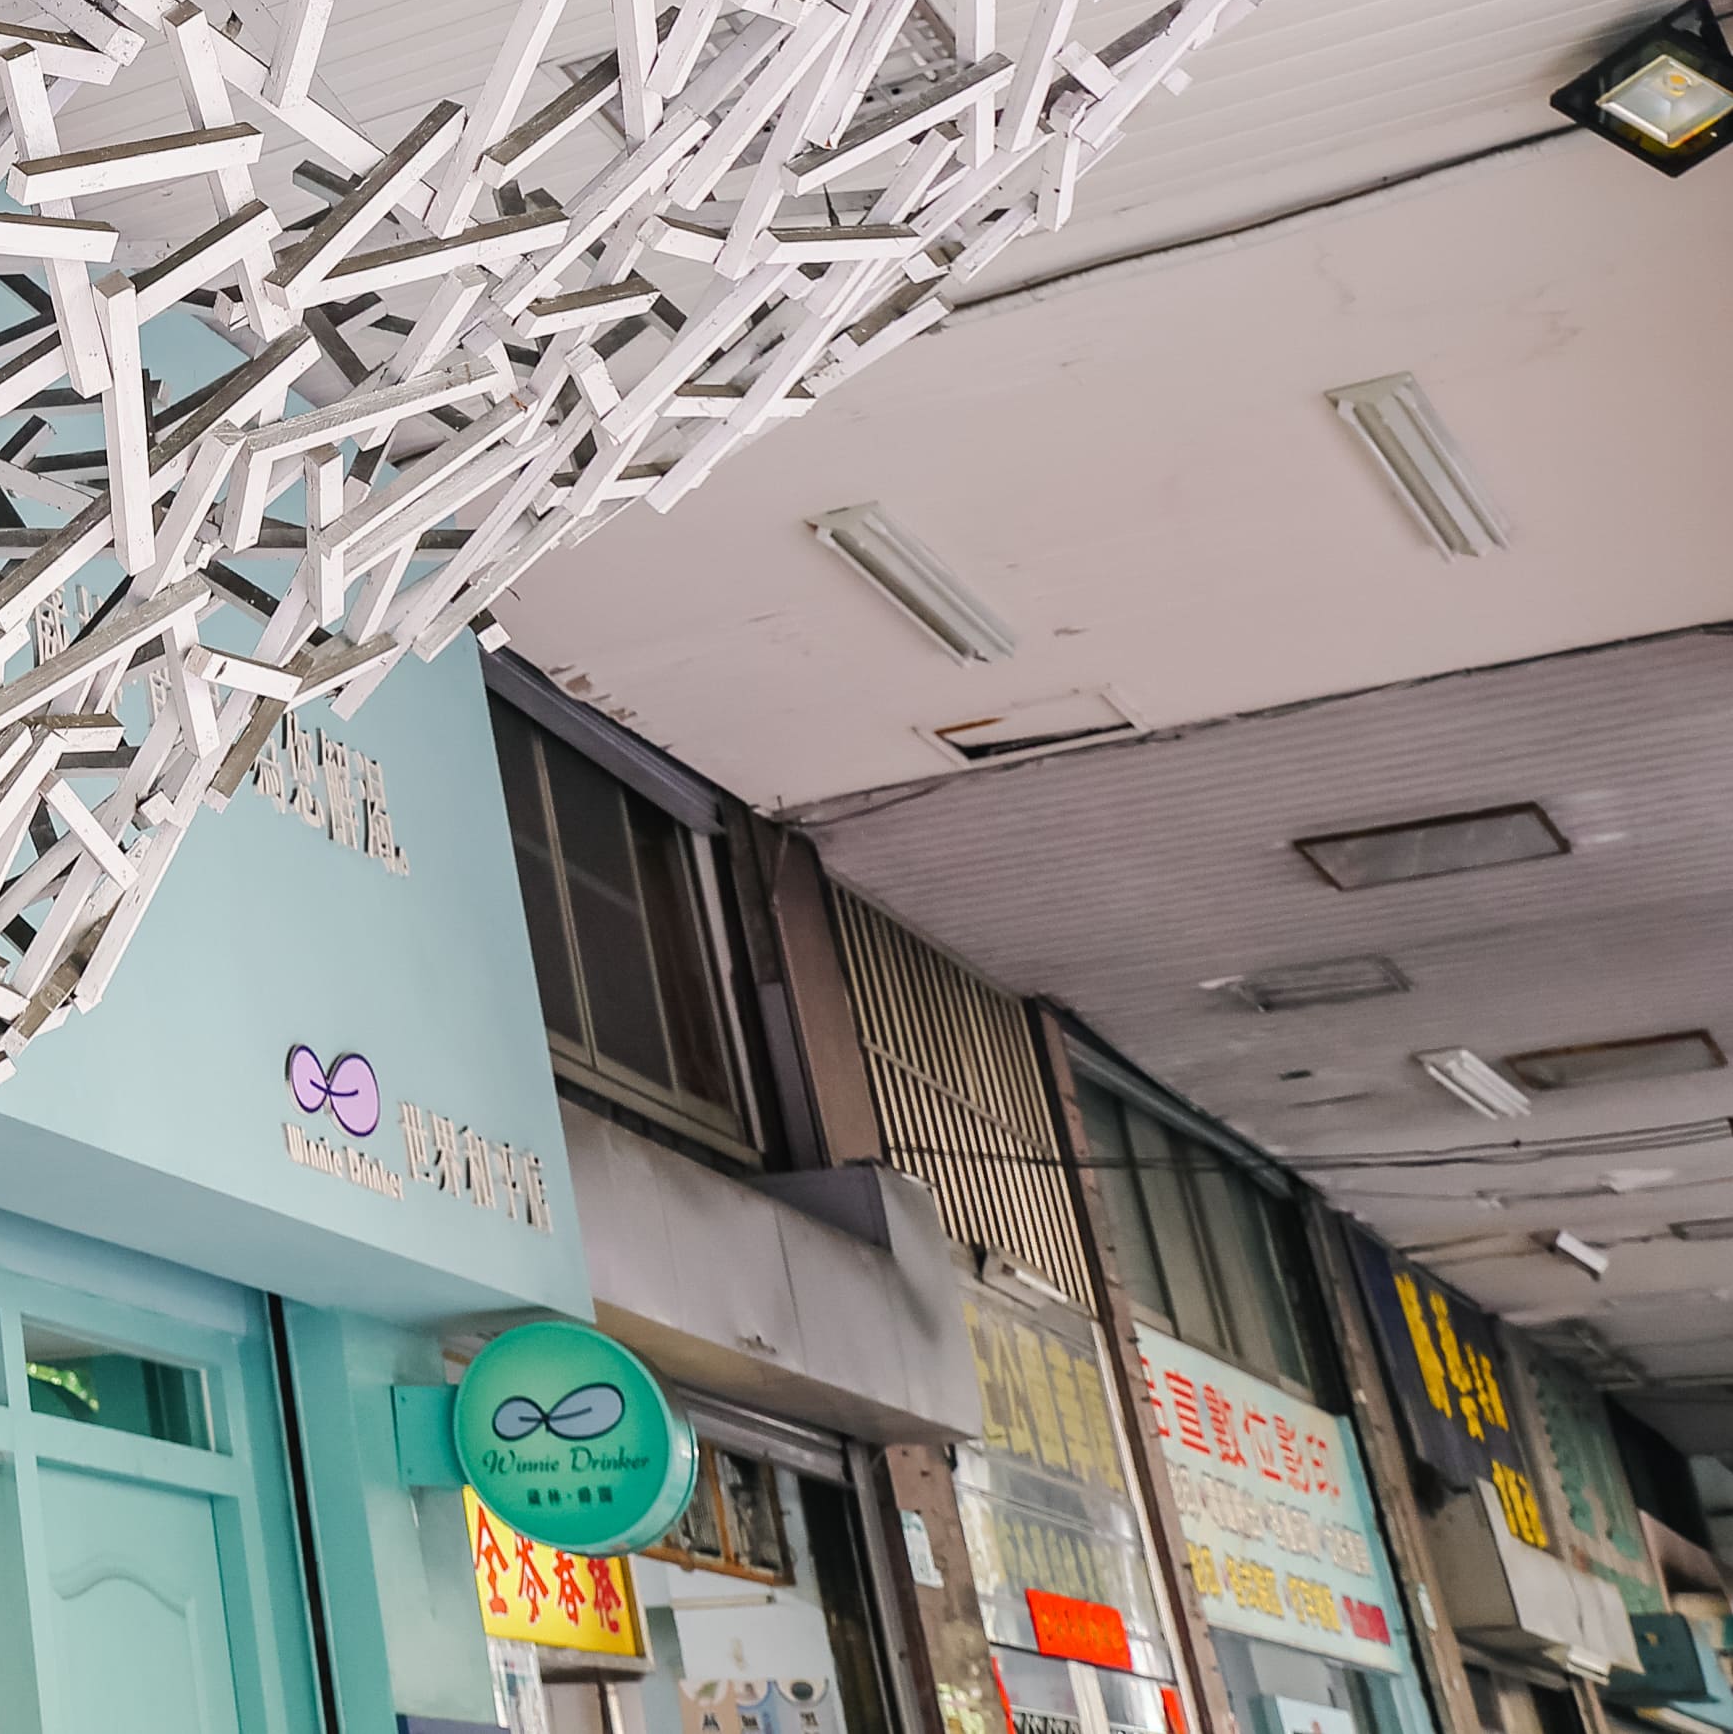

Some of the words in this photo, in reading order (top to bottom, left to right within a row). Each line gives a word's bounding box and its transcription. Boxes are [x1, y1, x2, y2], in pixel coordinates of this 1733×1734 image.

[398, 1100, 553, 1233] 世界和平店
[483, 1448, 560, 1476] Winnie
[570, 1444, 651, 1473] Drinker
